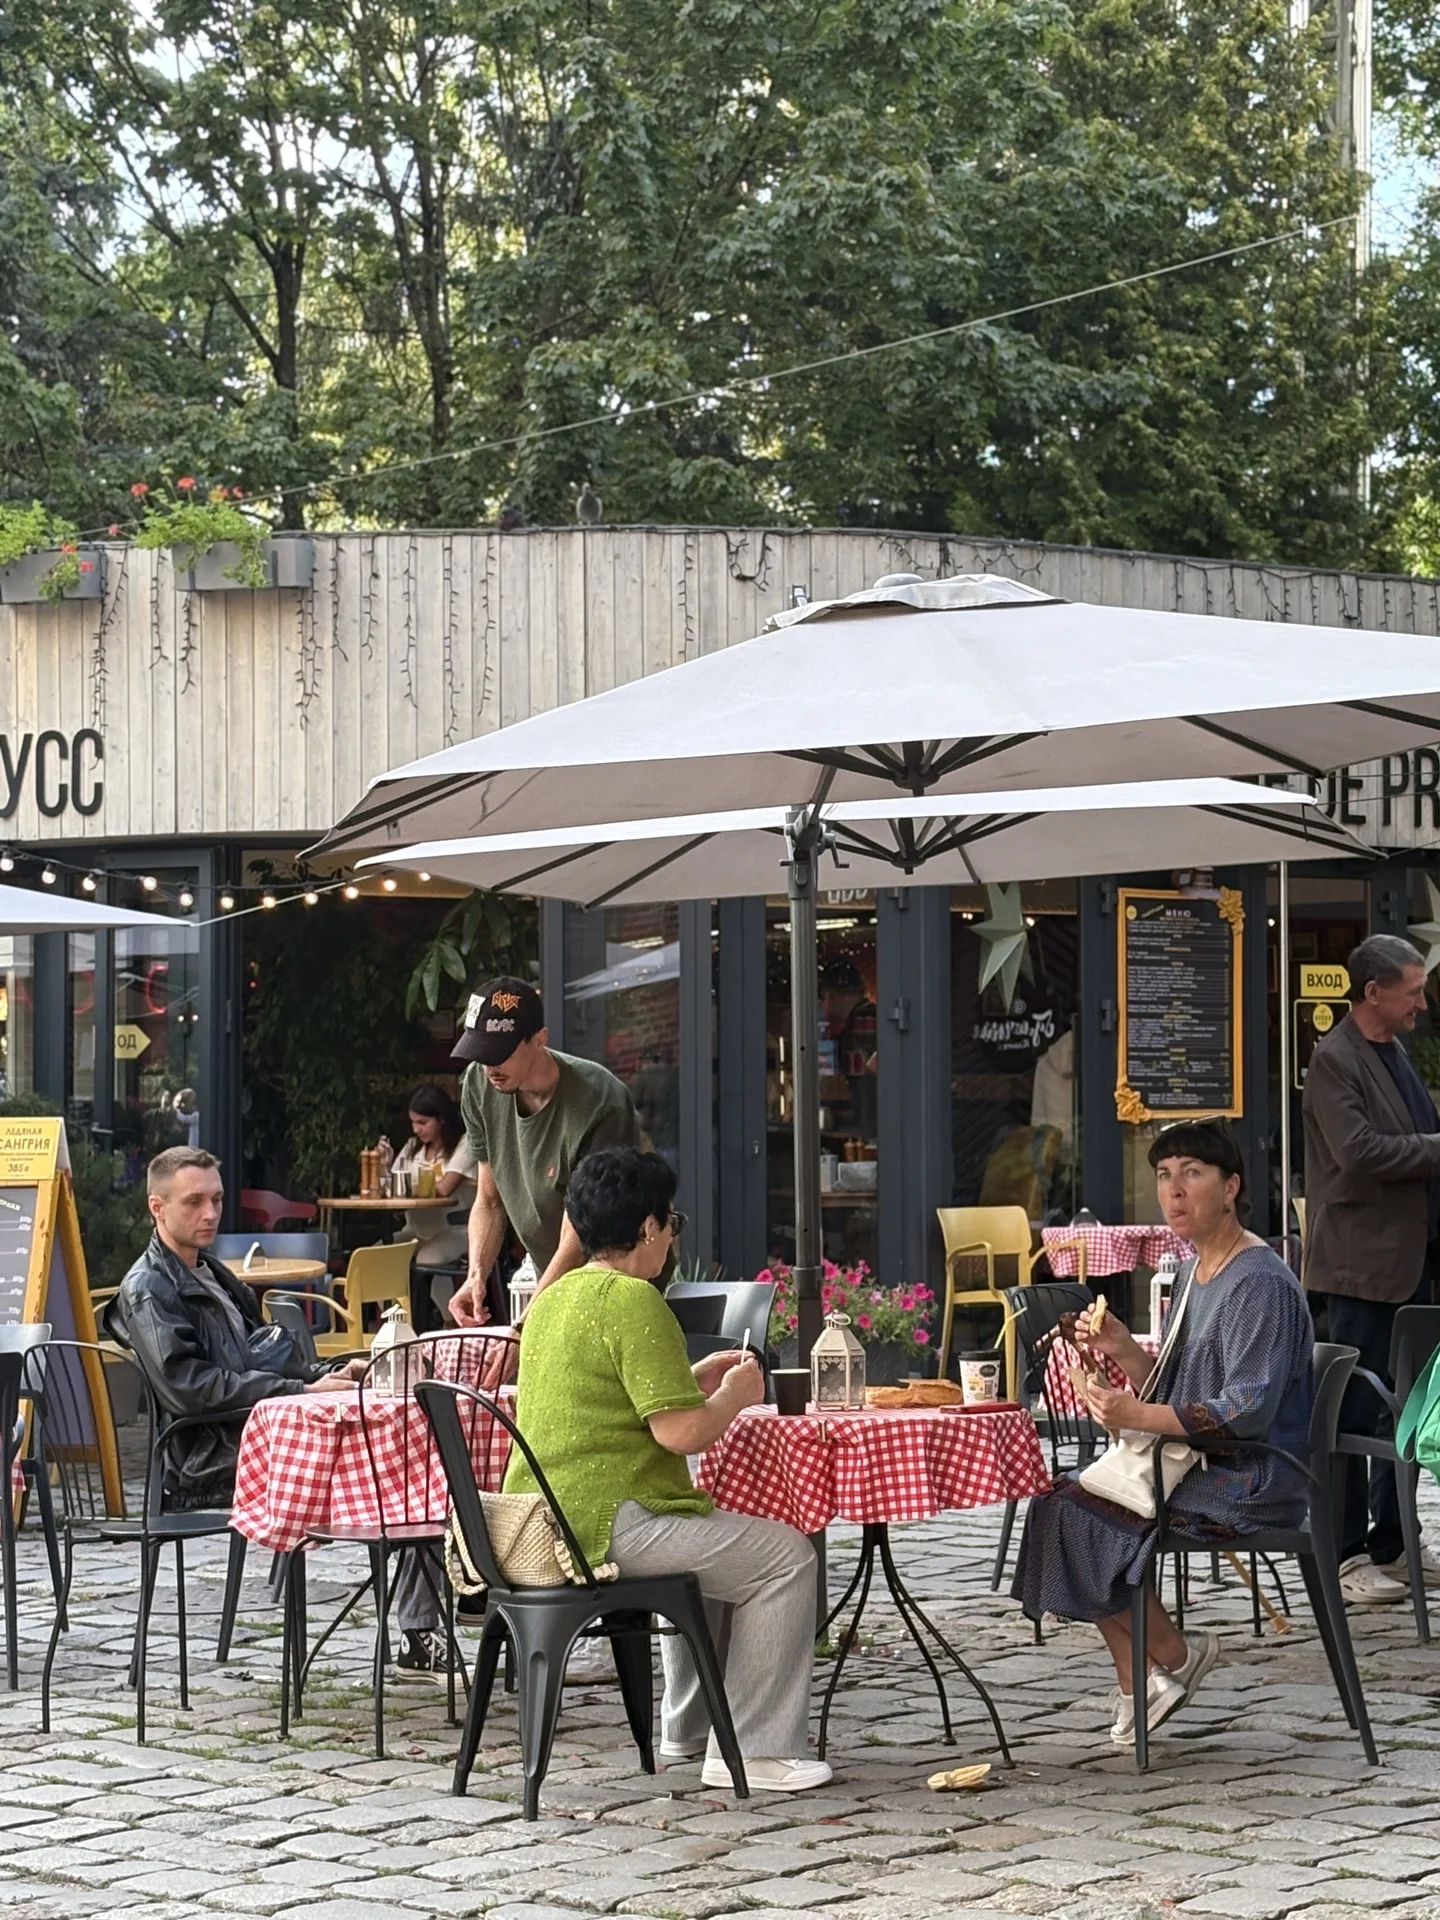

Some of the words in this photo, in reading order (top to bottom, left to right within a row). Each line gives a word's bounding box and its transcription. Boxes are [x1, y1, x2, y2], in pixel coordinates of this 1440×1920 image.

[0, 729, 103, 818] УСС
[1382, 748, 1440, 828] PR
[1306, 973, 1343, 990] ВХОД
[115, 1034, 137, 1051] ОД
[5, 1127, 42, 1136] ЛЕДЯНАЯ
